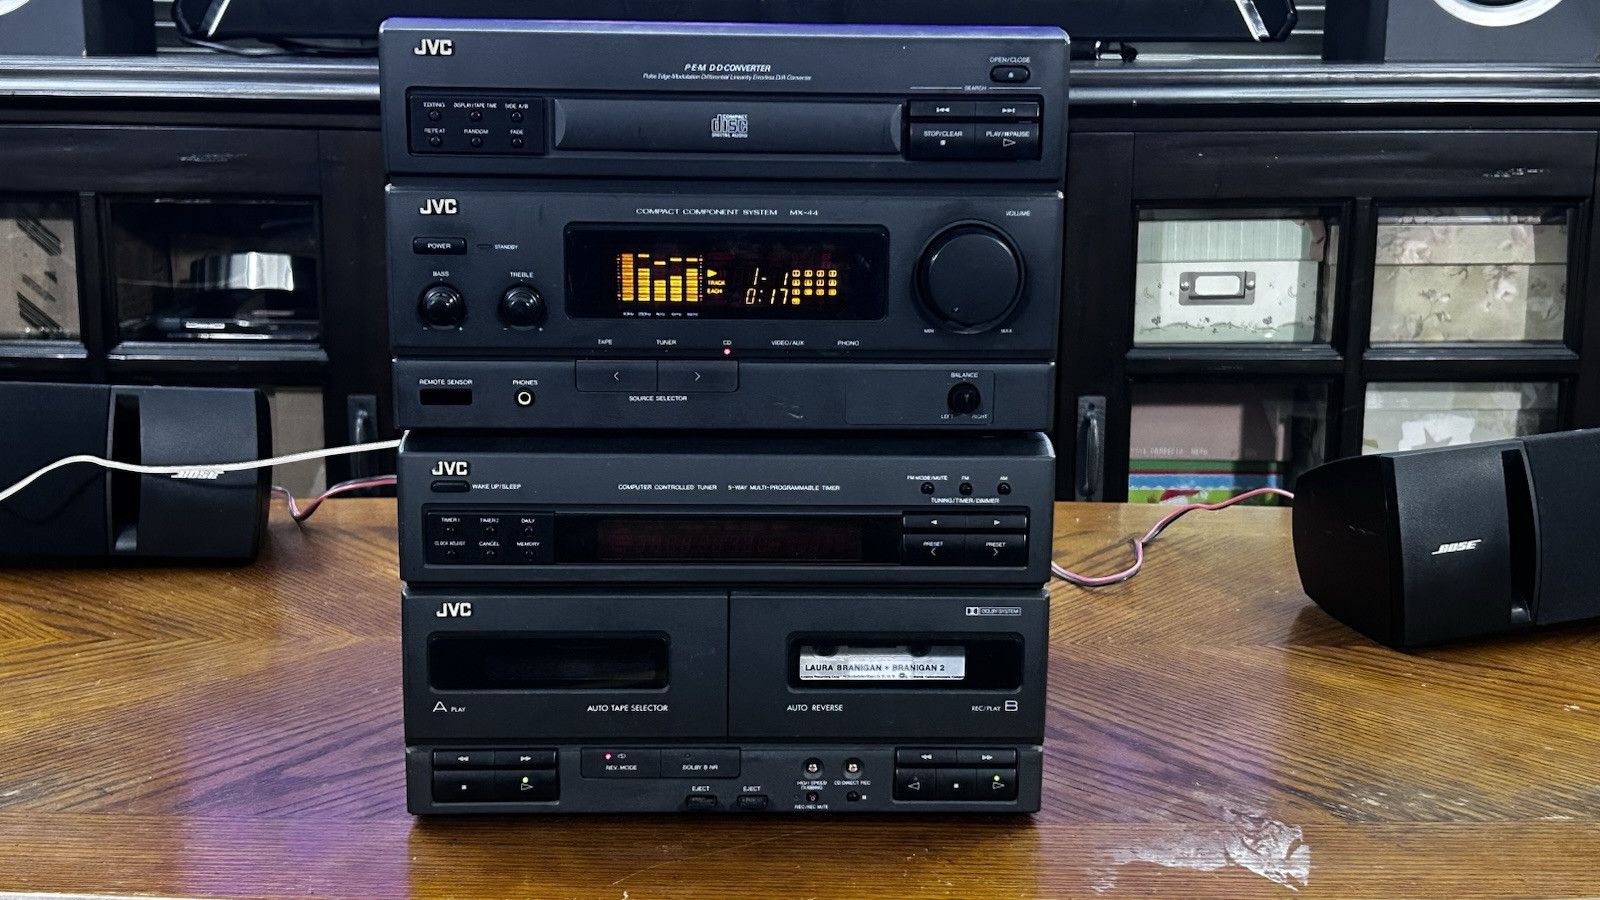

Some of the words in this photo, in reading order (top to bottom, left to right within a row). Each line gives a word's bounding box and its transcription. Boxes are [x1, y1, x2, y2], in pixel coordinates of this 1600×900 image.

[414, 39, 453, 56] JVC
[989, 56, 1031, 64] OPEN/CLOSE
[711, 114, 748, 132] disc
[419, 199, 457, 215] JVC
[682, 208, 739, 216] COMPONENT
[418, 378, 446, 386] REMOTE
[431, 461, 468, 476] JVC
[749, 484, 820, 492] MULTI-PROGRAMMABLE
[931, 497, 1000, 505] TUNING/TIMER/DIMMER
[1431, 539, 1482, 555] BOSE
[436, 602, 472, 618] JVC
[805, 664, 834, 672] LAURA
[836, 664, 882, 672] BRANIGAN
[892, 664, 938, 672] BRANIGAN
[939, 664, 945, 672] 2
[432, 701, 447, 713] A
[587, 704, 609, 712] AUTO
[611, 704, 629, 712] TAPE
[631, 704, 669, 712] SELECTOR
[787, 704, 808, 712] AUTO
[811, 704, 844, 712] REVERSE
